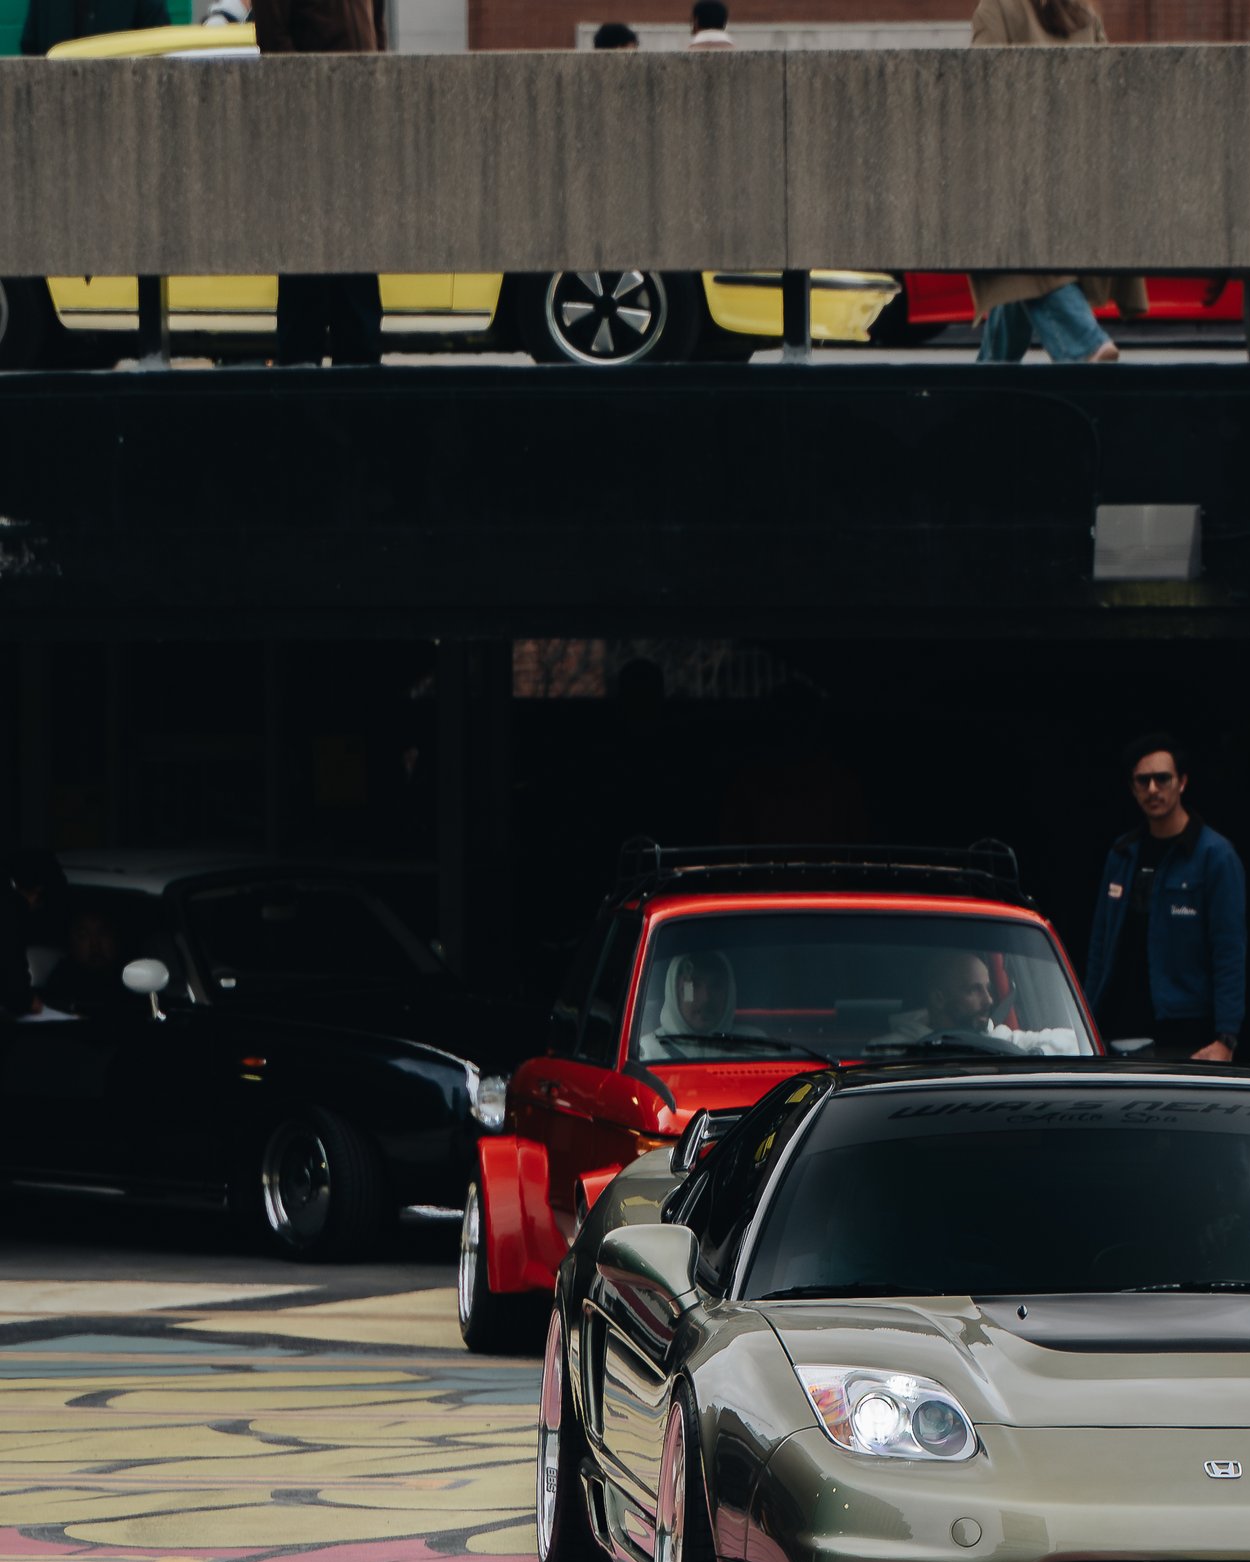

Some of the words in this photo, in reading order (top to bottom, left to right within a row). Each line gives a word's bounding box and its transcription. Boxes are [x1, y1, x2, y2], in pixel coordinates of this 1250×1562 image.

[1007, 1111, 1104, 1124] Auto
[1120, 1112, 1178, 1124] Spa
[546, 1466, 557, 1494] BBS
